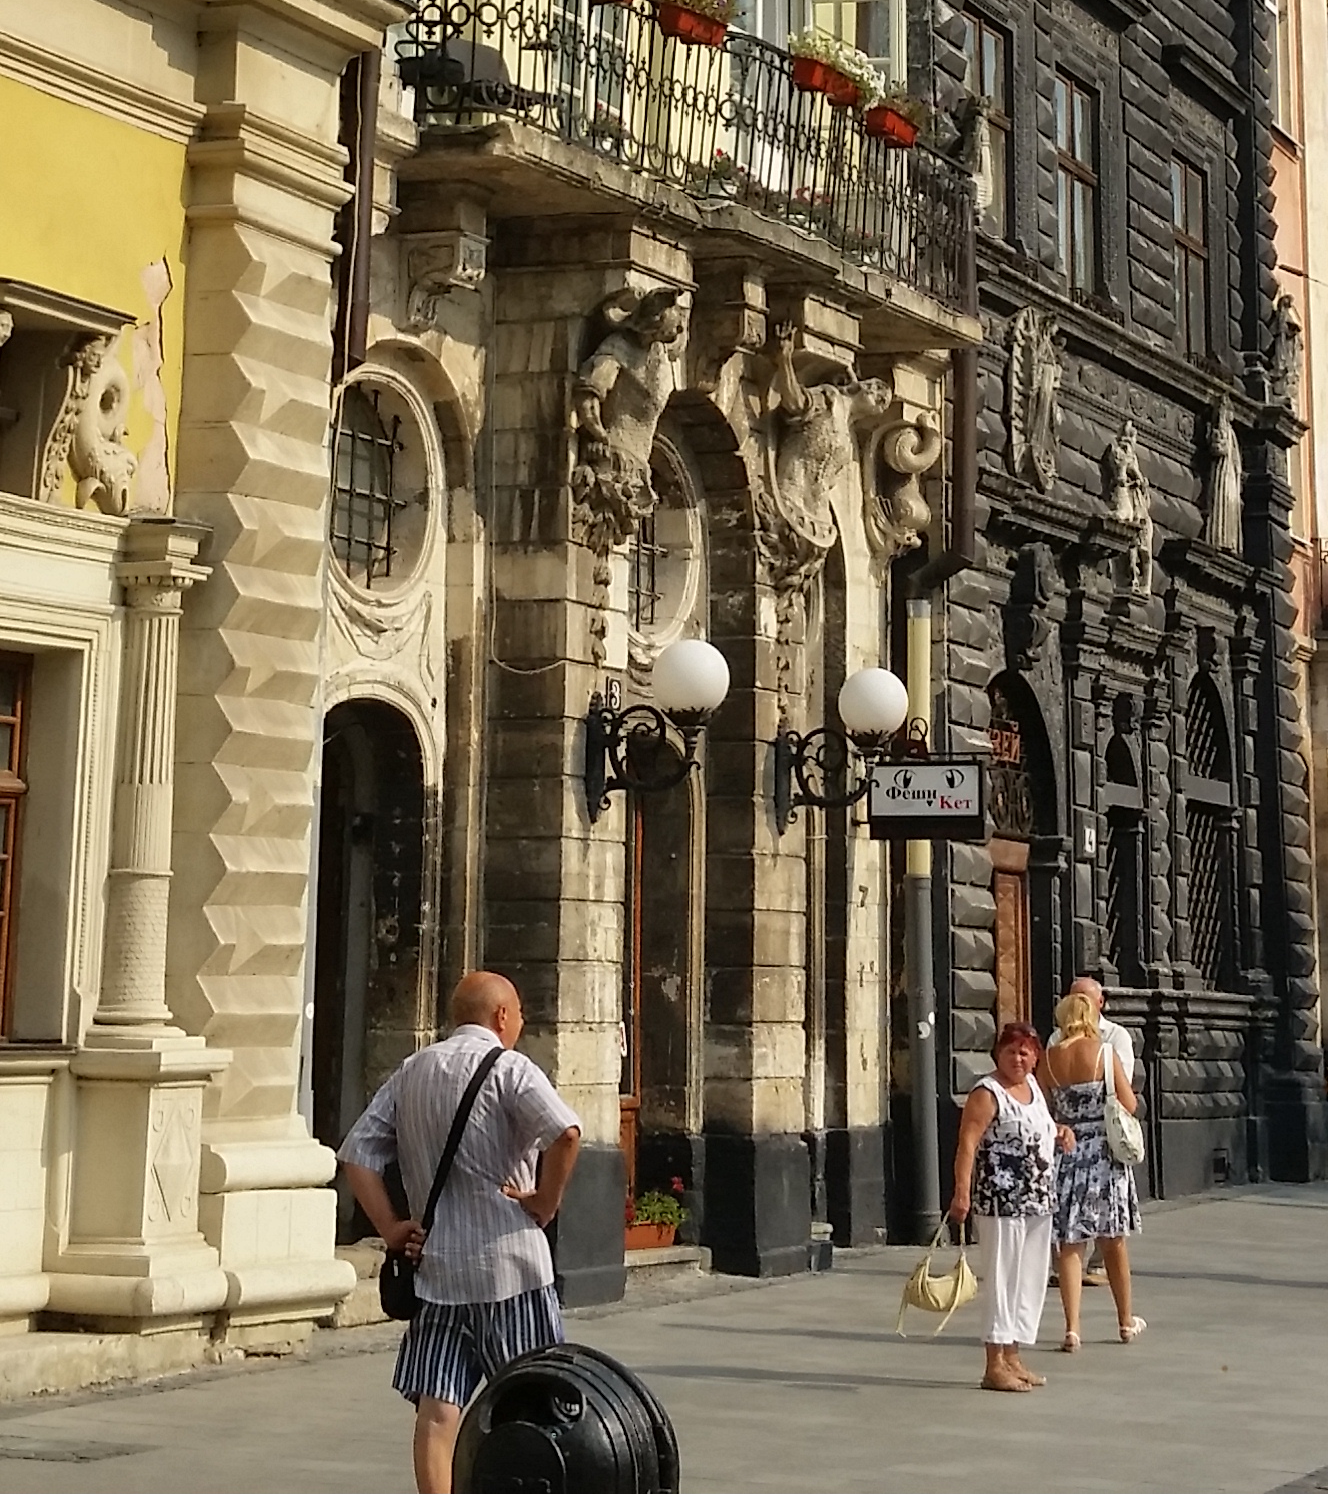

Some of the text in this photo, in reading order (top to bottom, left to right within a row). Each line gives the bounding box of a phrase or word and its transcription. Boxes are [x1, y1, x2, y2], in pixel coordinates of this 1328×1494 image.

[611, 680, 621, 710] 3
[988, 720, 1021, 764] ЗЕЙ
[939, 795, 973, 810] Кет
